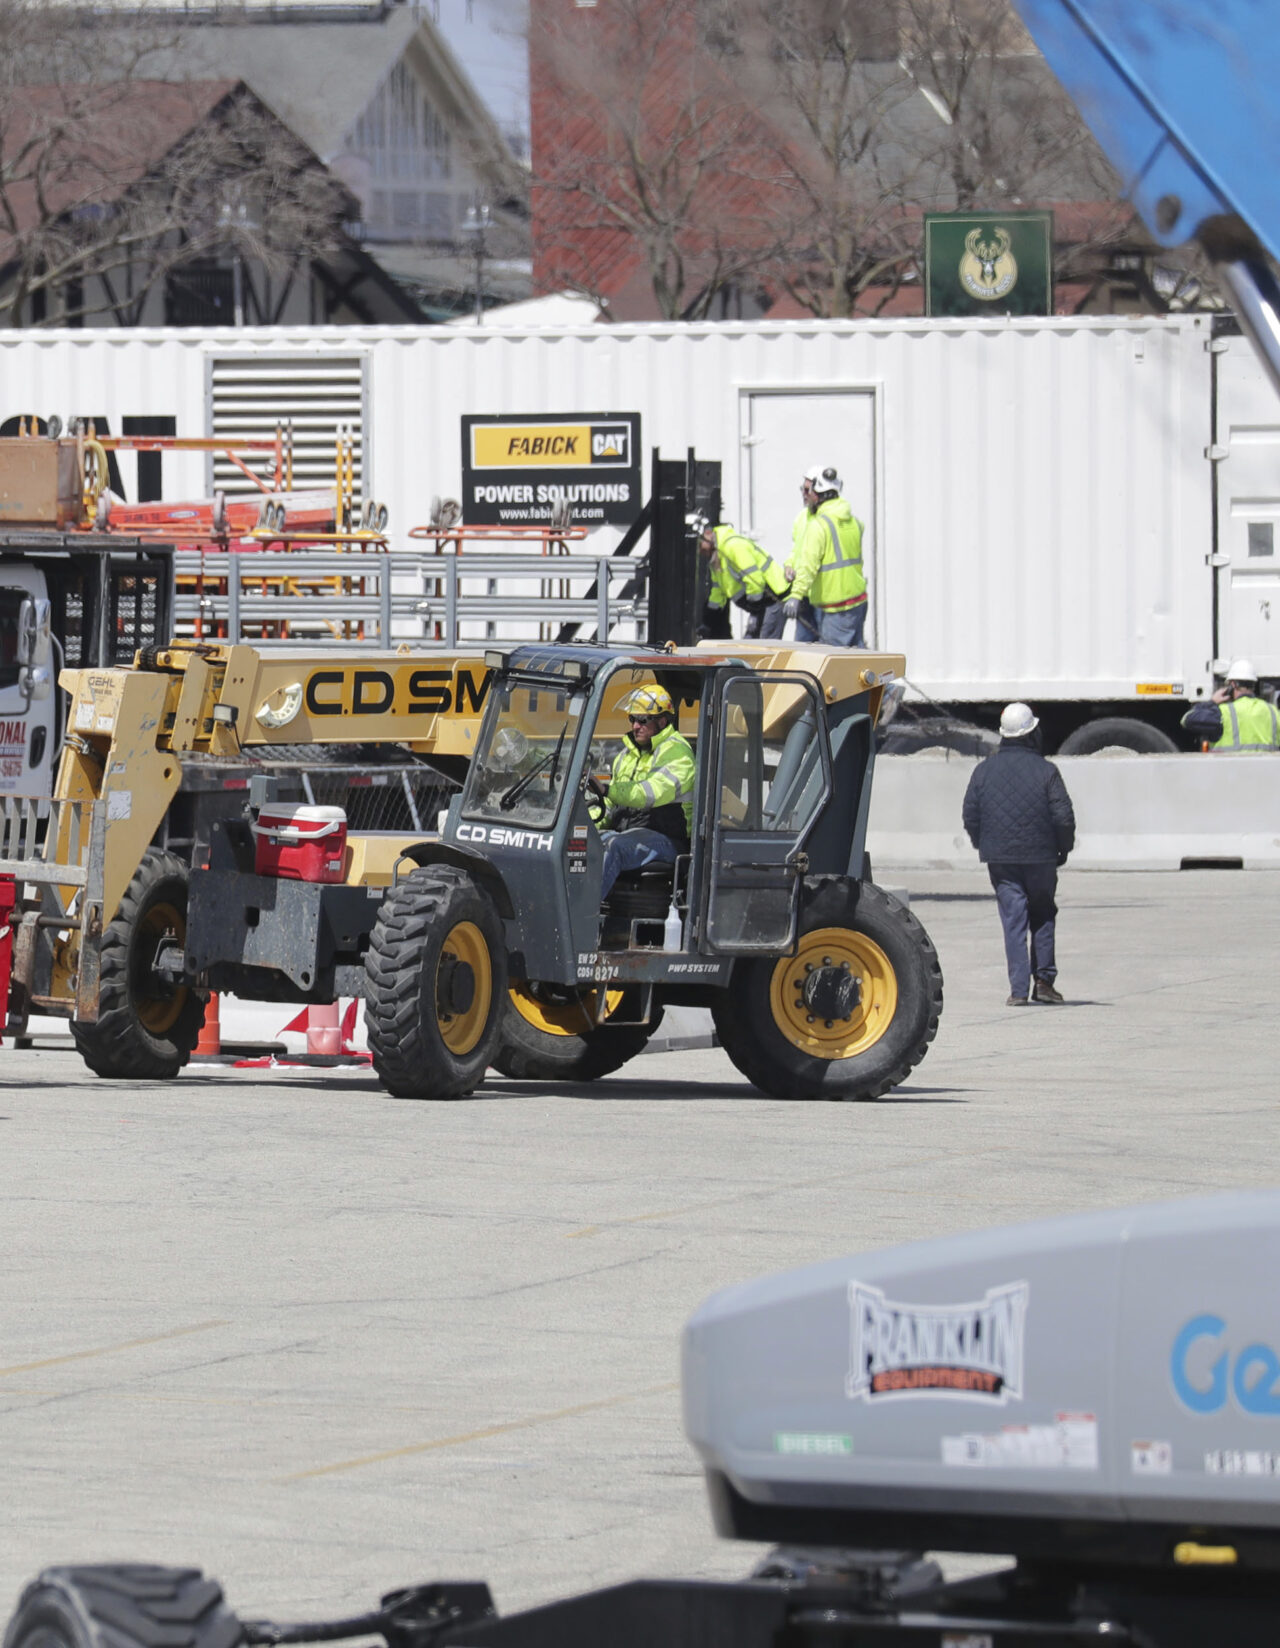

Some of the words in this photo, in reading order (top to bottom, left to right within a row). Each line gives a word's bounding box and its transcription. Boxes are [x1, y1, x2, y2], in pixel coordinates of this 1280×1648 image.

[507, 436, 578, 456] FABICK
[592, 433, 626, 456] CAT
[474, 485, 533, 503] POWER
[537, 483, 629, 502] SOLUTIONS
[306, 671, 396, 715] C.D.
[488, 829, 553, 850] SMITH
[687, 964, 720, 972] SYSTEM
[851, 1290, 1025, 1394] FRANKLIN
[872, 1366, 999, 1392] EQUIPMENT
[780, 1435, 848, 1453] DIESEL
